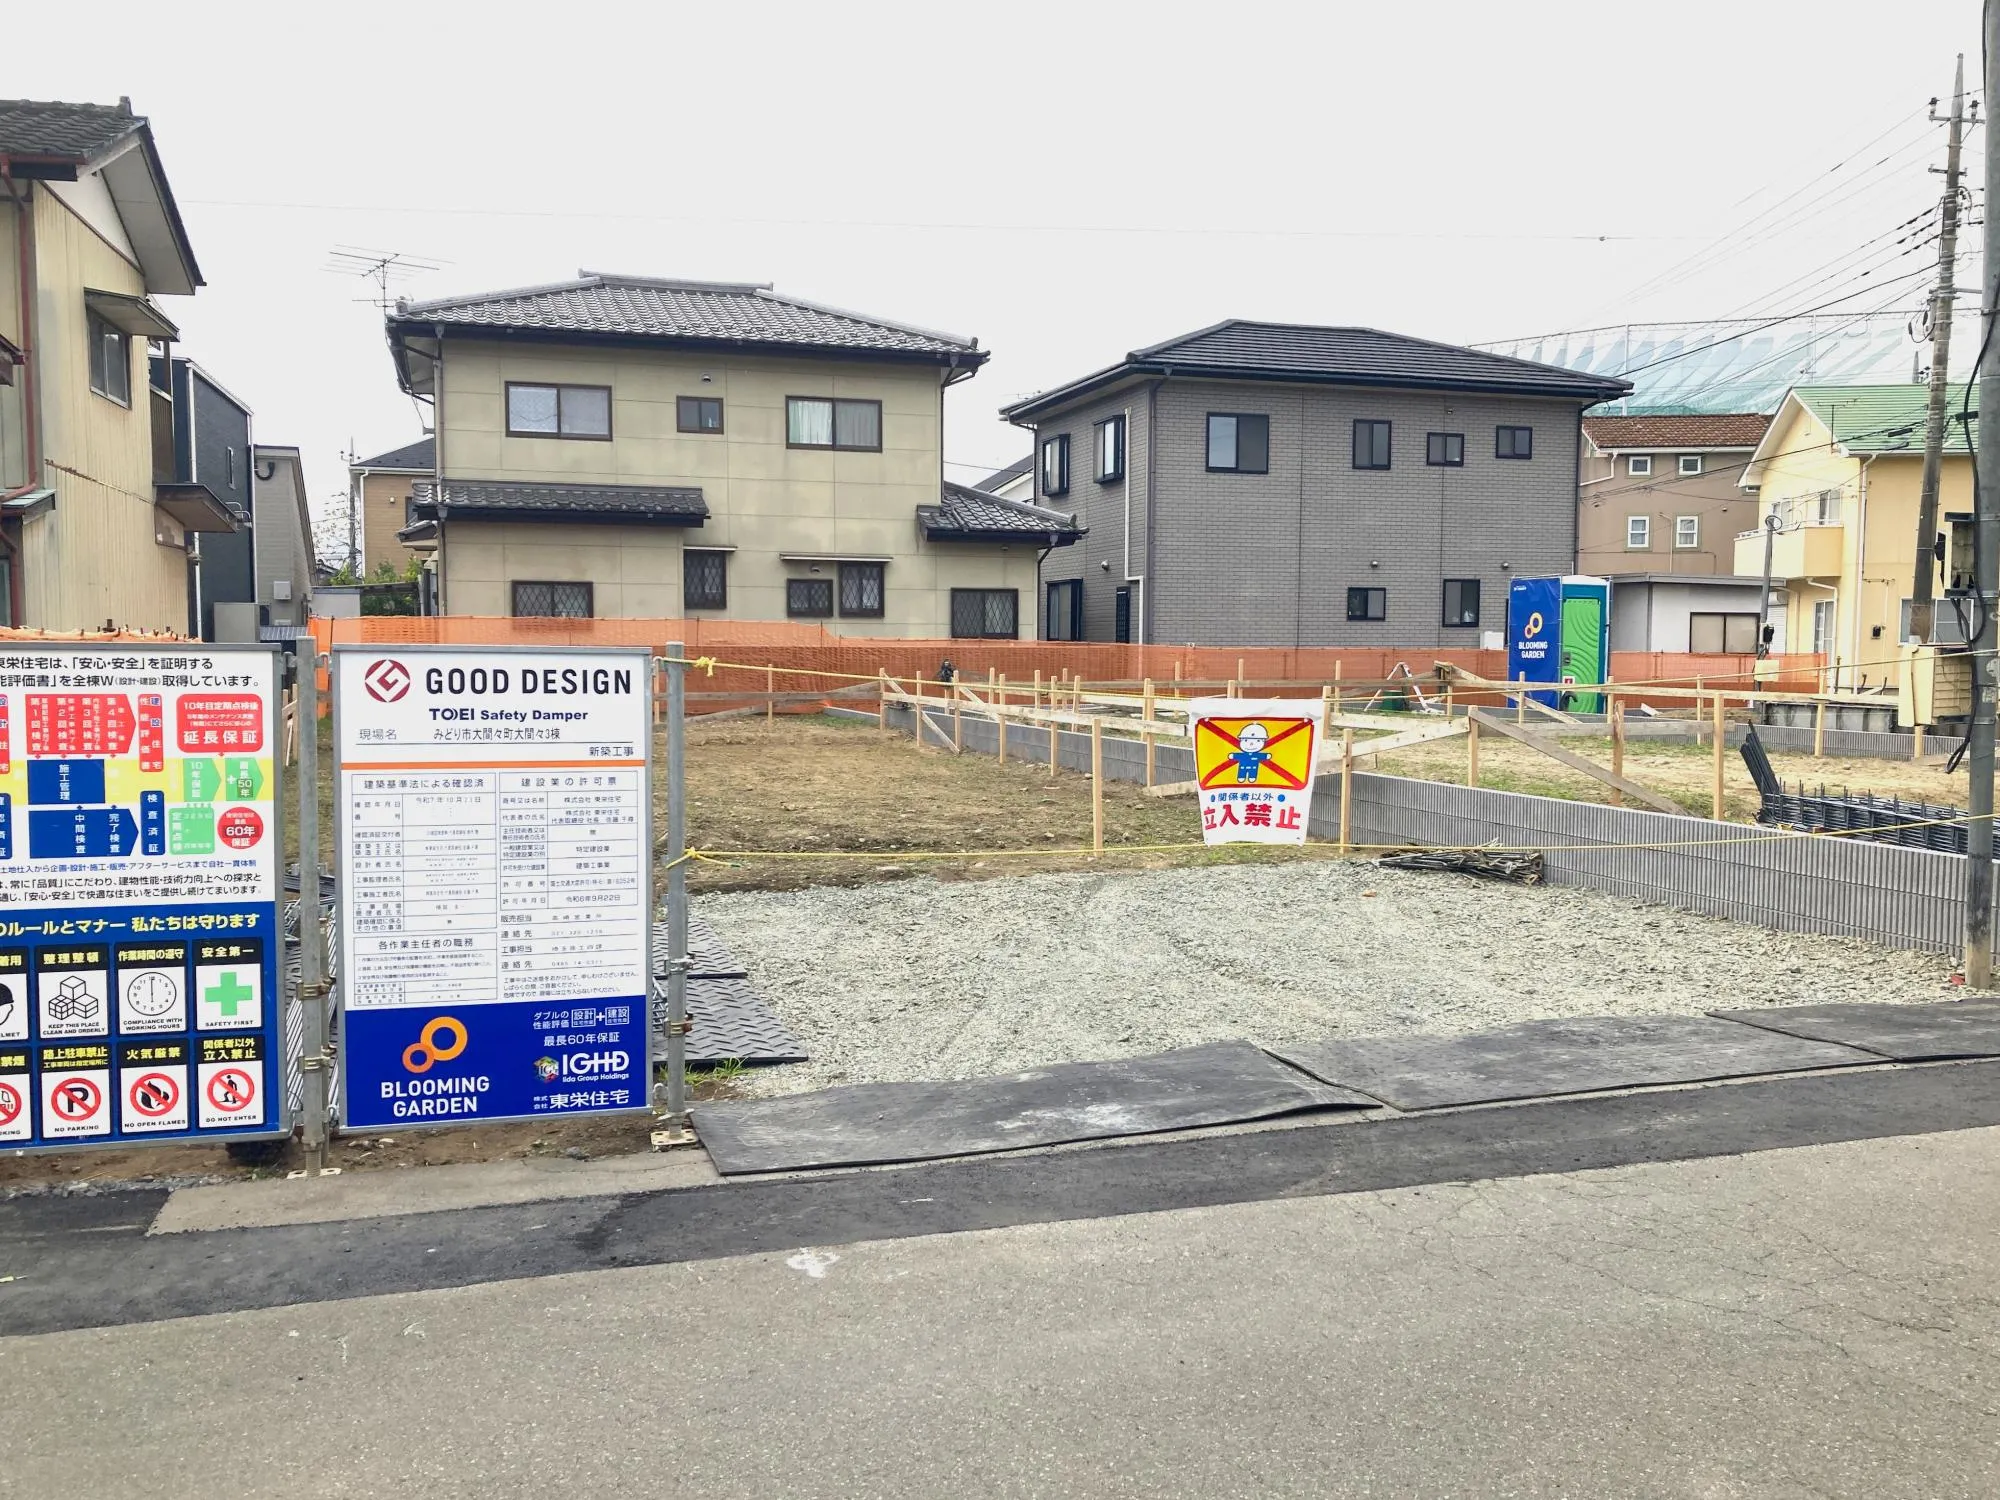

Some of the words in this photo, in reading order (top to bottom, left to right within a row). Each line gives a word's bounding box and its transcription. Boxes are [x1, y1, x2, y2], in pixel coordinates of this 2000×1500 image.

[1518, 641, 1548, 650] BLOOMING
[1521, 650, 1545, 659] GARDEN
[426, 667, 509, 695] GOOD
[521, 668, 632, 695] DESIGN
[429, 708, 474, 721] TOEI
[480, 709, 527, 723] Safety
[532, 709, 588, 722] Damper
[183, 730, 257, 745] 延長保証
[359, 728, 398, 741] 現場名
[433, 727, 561, 741] みどり市大間々町大間々3棟
[588, 746, 634, 757] 新築工事
[59, 764, 70, 801] 施工管理
[364, 779, 484, 789] 建築基準法による確認済
[521, 777, 617, 787] 建設業の許可票
[1217, 792, 1274, 801] 関係者以外
[1203, 803, 1302, 830] 立入禁止
[147, 794, 159, 853] 検査済証
[75, 814, 86, 854] 中間検査
[109, 813, 120, 853] 完了検査
[226, 826, 255, 837] 60年
[231, 837, 251, 847] 保証
[132, 914, 260, 933] 私たちは守ります
[500, 914, 532, 923] 販売担当
[500, 930, 533, 938] 連絡先
[378, 937, 474, 950] 各作業主任者の職務
[501, 945, 532, 954] 工事担当
[201, 946, 254, 958] 安全第一
[43, 952, 99, 965] 整理整頓
[501, 961, 533, 969] 連絡先
[533, 1010, 570, 1021] ダブルの
[573, 1010, 594, 1021] 設計
[607, 1008, 628, 1019] 建設
[532, 1019, 570, 1030] 性能評価
[203, 1037, 255, 1050] 関係者以外
[543, 1031, 620, 1047] 最長60年保証
[127, 1047, 181, 1060] 火気厳禁
[203, 1049, 256, 1061] 立入禁止
[562, 1050, 630, 1075] IGHD
[577, 1074, 599, 1082] Group
[600, 1072, 630, 1081] Holdings
[380, 1075, 490, 1099] BLOOMING
[549, 1089, 630, 1109] 東栄住宅
[392, 1096, 478, 1118] GARDEN
